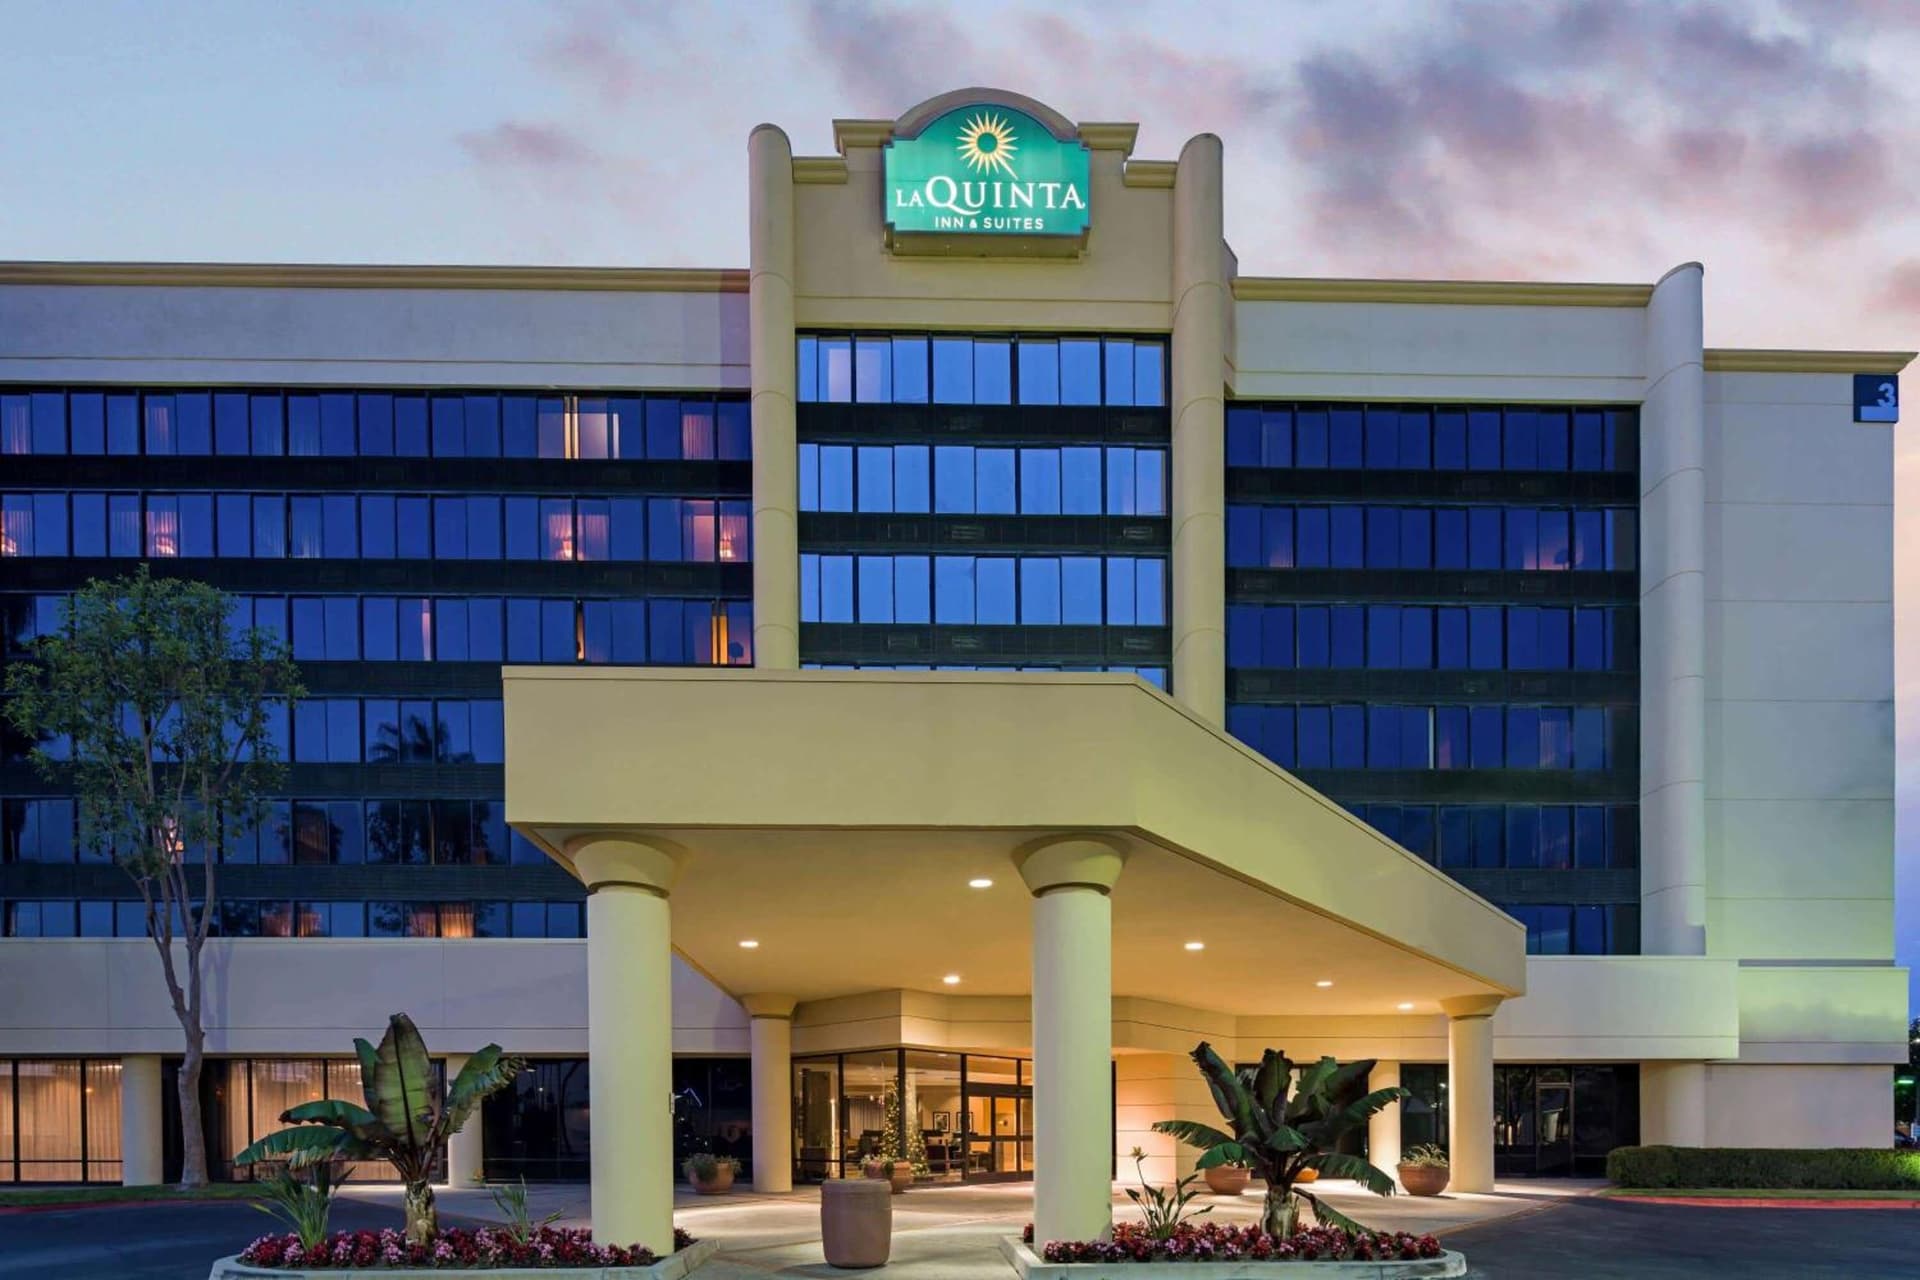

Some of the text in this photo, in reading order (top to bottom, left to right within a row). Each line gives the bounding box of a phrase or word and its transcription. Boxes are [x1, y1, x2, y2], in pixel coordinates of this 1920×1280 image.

[895, 176, 1086, 215] LA QUINTA
[935, 216, 964, 229] INN
[983, 217, 1044, 230] SUITES
[1877, 382, 1896, 407] 3
